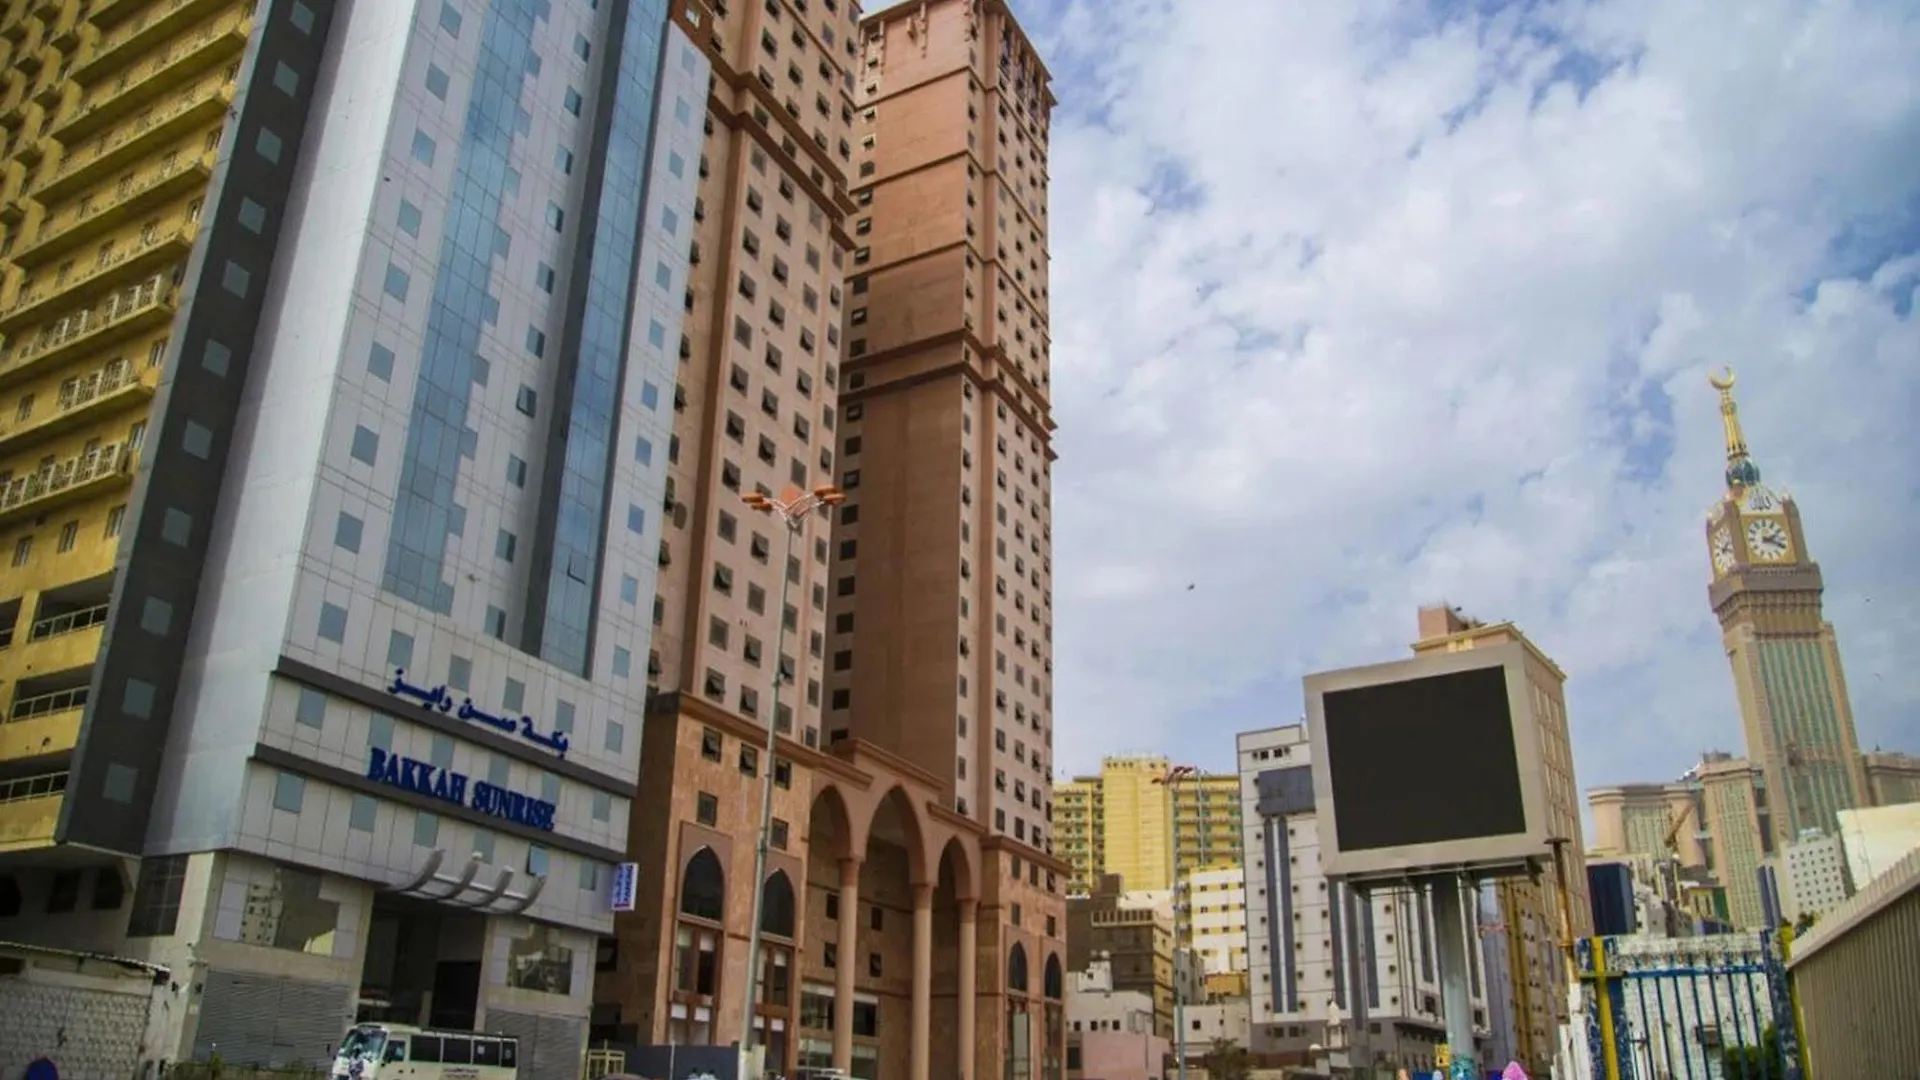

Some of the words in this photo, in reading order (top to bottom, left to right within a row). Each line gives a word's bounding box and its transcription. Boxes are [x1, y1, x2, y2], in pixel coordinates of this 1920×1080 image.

[387, 668, 452, 712] رايز
[458, 697, 517, 733] سن
[521, 716, 568, 759] بكة
[367, 747, 468, 806] BAKKAH
[472, 780, 556, 831] SUNRISE
